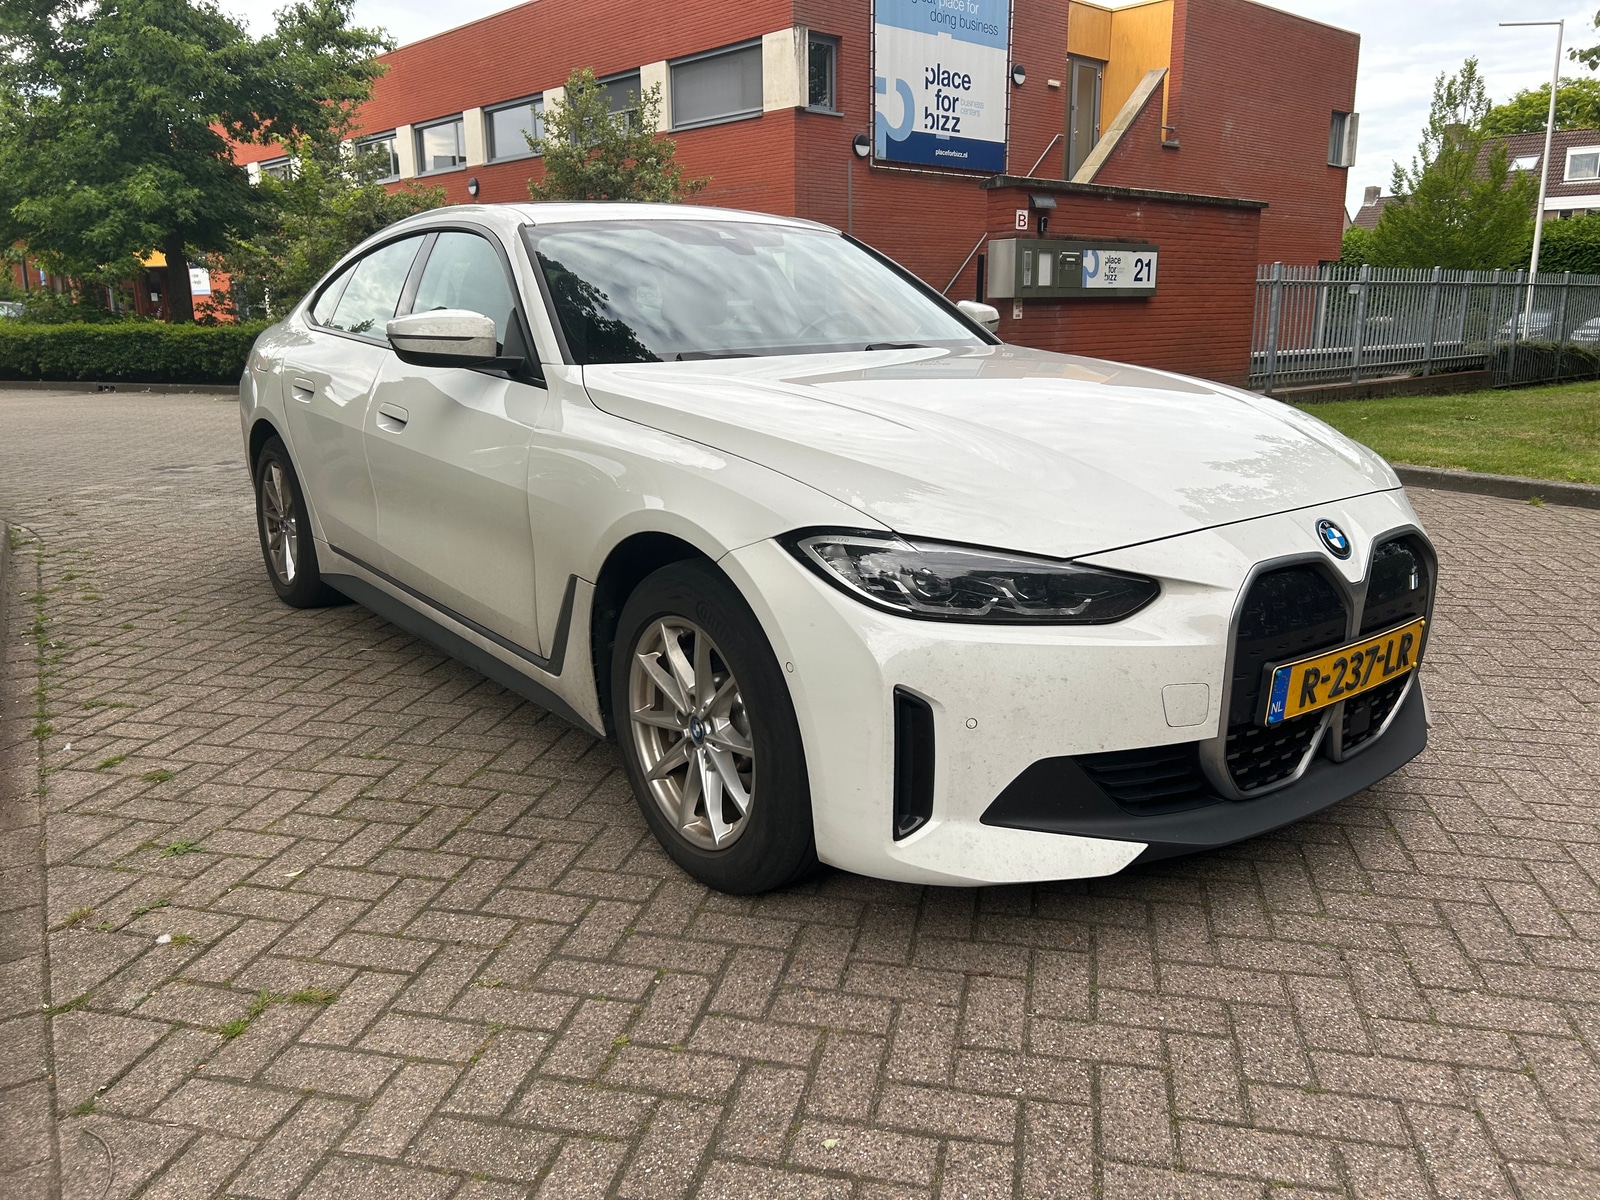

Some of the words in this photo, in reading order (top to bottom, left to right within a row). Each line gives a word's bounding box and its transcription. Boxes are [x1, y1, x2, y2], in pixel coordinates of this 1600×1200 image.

[938, 0, 965, 11] place
[967, 0, 979, 14] for
[930, 9, 956, 30] doing
[960, 14, 999, 36] business
[925, 63, 971, 91] place
[935, 88, 959, 112] for
[961, 98, 984, 109] business
[961, 107, 980, 117] centers
[924, 106, 960, 133] bizz
[935, 149, 968, 158] placeforbizz.nl
[1018, 214, 1026, 226] B
[1105, 255, 1121, 266] place
[1108, 265, 1117, 273] for
[1133, 258, 1151, 281] 21
[1104, 272, 1117, 281] bizz
[1299, 632, 1413, 709] R-237-LR
[1270, 701, 1283, 715] NL
